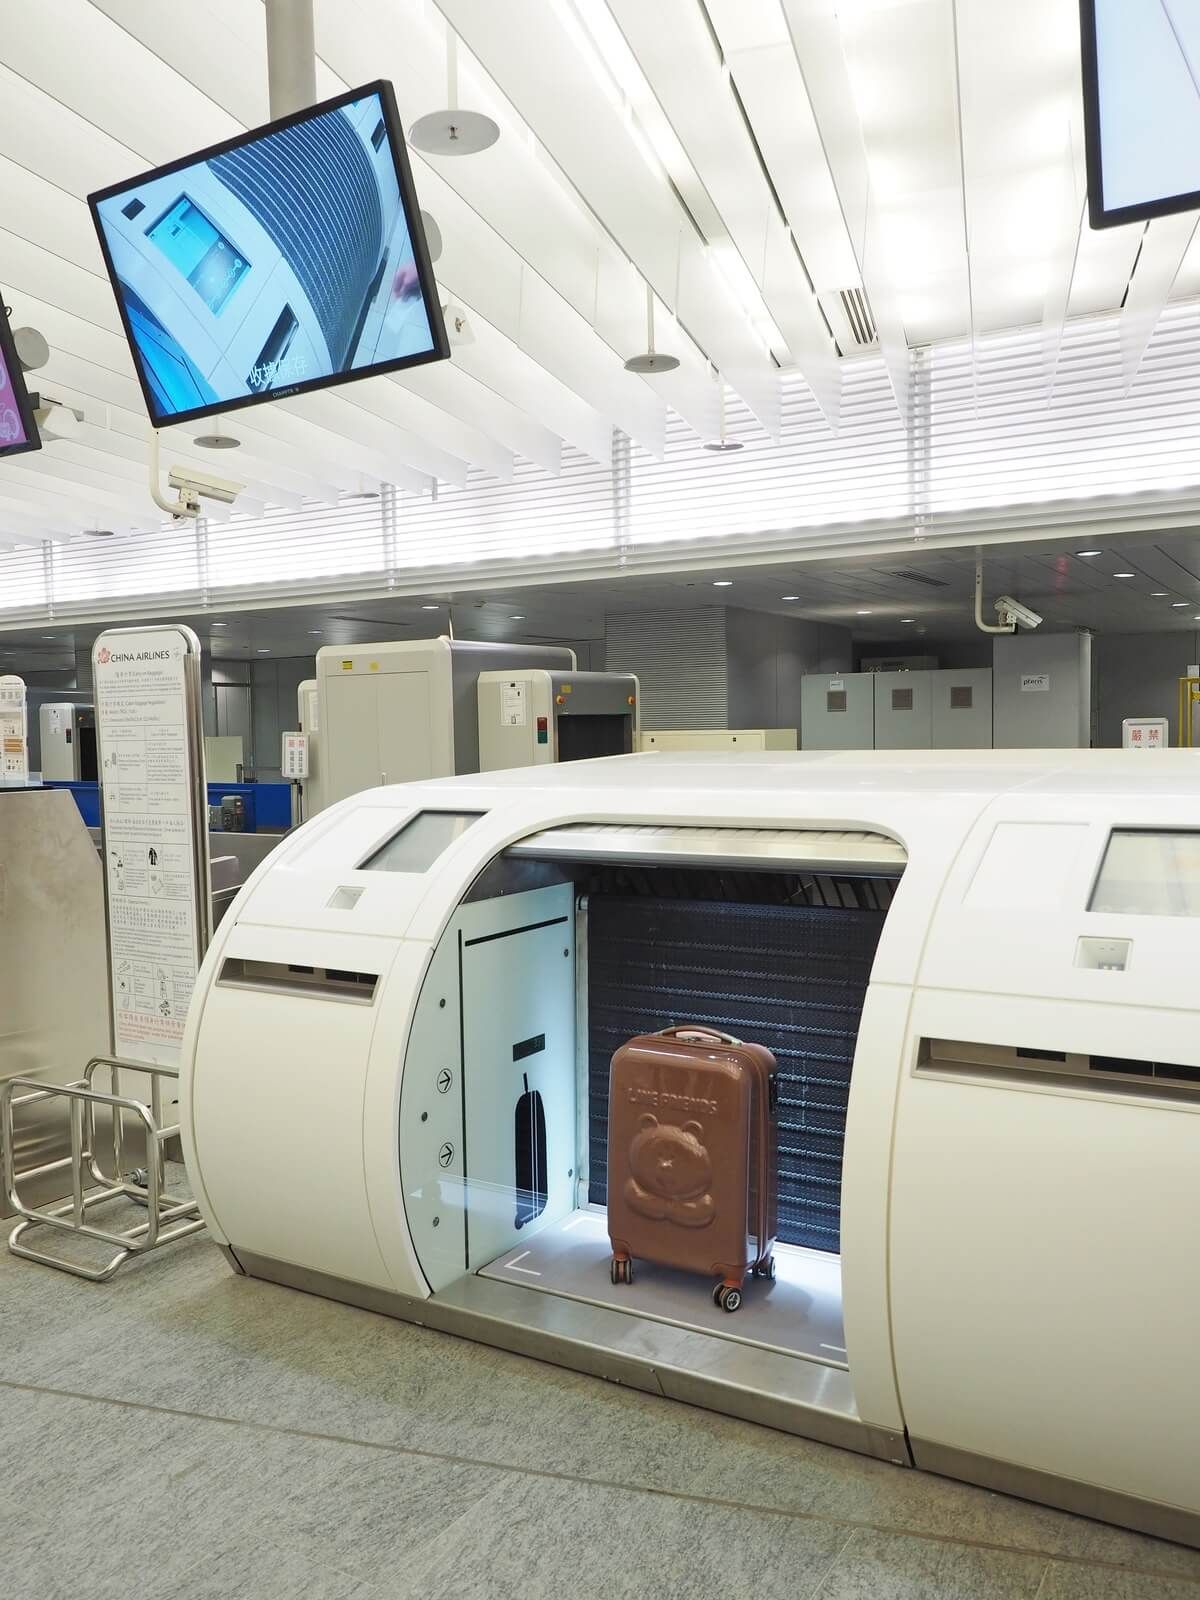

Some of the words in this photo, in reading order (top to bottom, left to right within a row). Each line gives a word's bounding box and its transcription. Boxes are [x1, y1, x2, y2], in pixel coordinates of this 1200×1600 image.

[110, 653, 136, 664] CHINA
[136, 651, 170, 662] AIRLINES
[627, 1087, 659, 1107] LINE
[660, 1091, 718, 1115] FRIENDS
